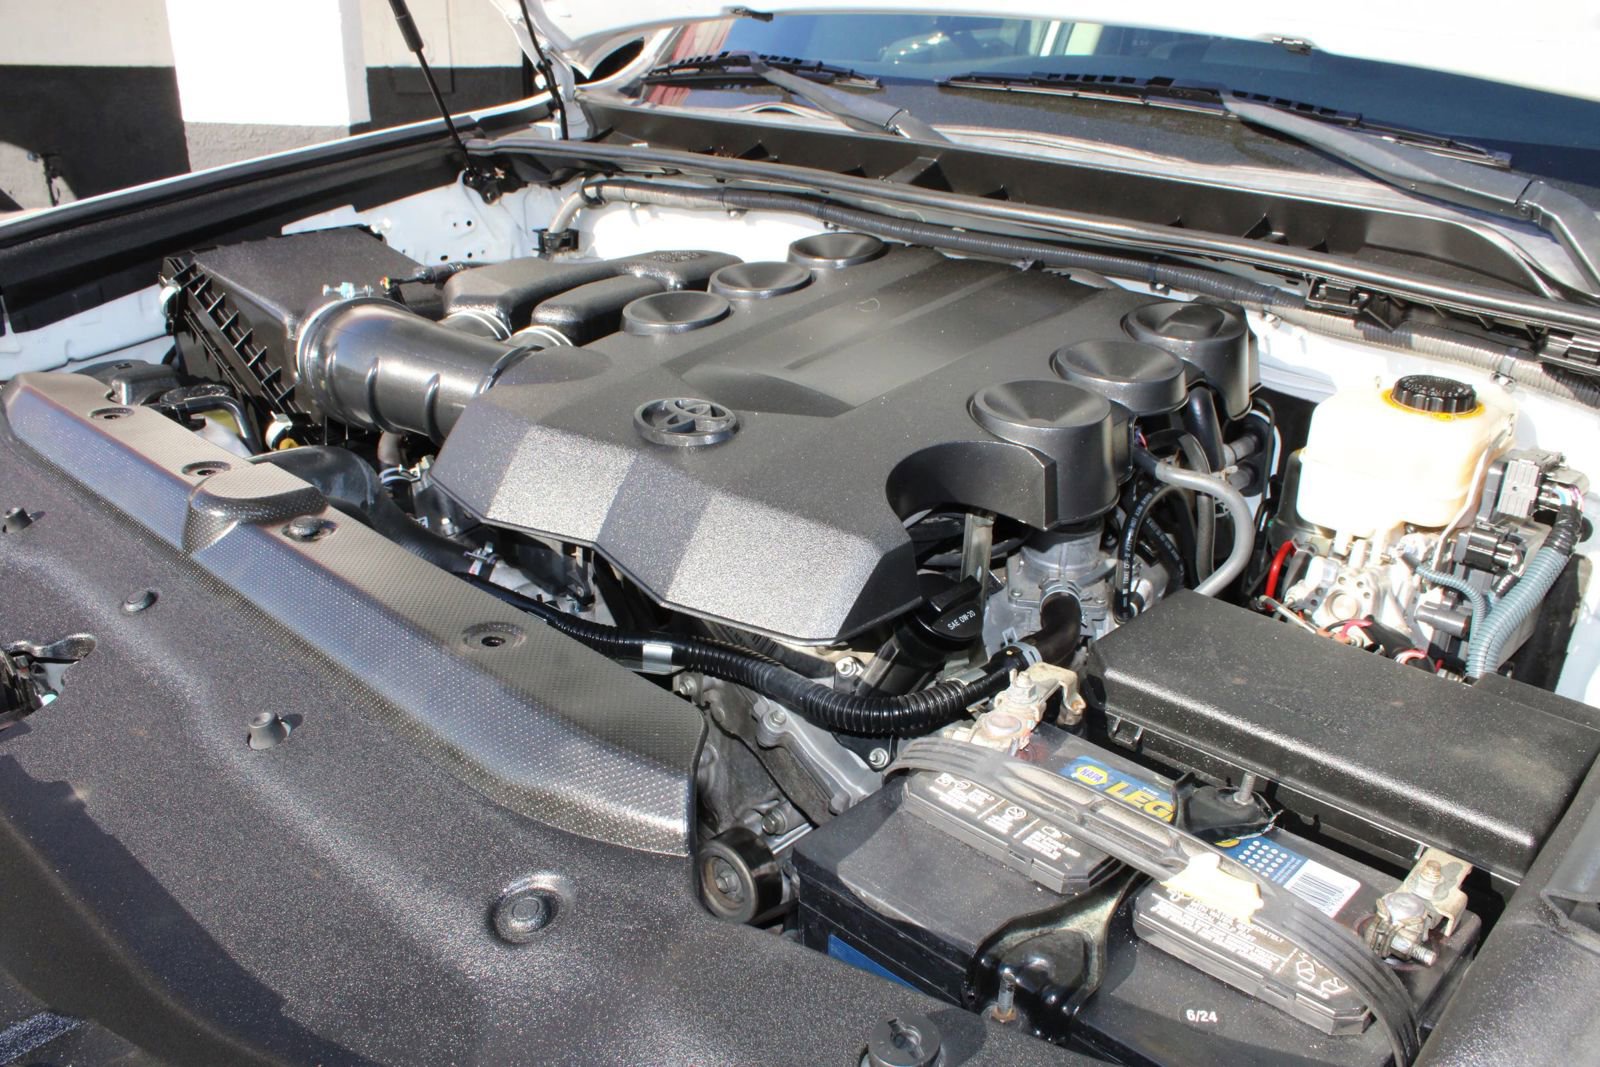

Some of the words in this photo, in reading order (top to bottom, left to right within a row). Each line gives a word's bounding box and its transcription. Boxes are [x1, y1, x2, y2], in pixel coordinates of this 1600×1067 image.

[947, 618, 960, 630] SAE
[1080, 768, 1104, 783] NAPA
[1104, 780, 1175, 822] LEG
[1186, 1009, 1218, 1023] 6/24
